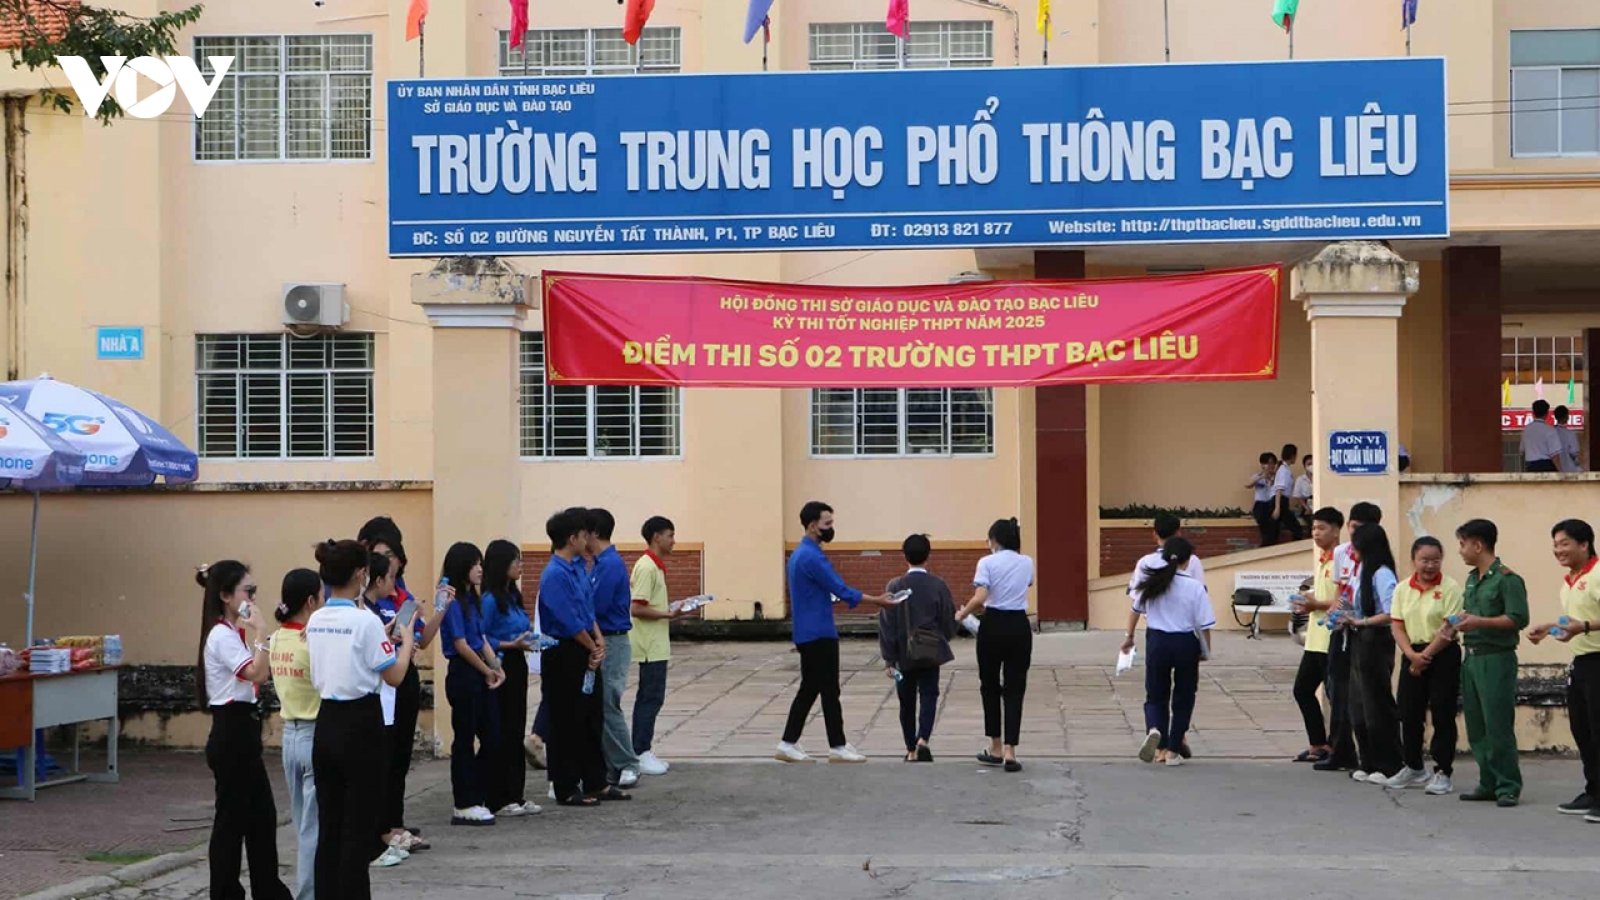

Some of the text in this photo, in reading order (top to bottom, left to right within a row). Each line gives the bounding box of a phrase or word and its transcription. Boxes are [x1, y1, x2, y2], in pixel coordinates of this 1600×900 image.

[398, 82, 595, 98] ỦY BAN NHÂN DÂN TỈNH BẠC LIÊU
[424, 99, 571, 115] SỞ GIÁO DỤC VÀ ĐÀO TẠO
[412, 96, 1417, 199] TRƯỜNG TRUNG HỌC PHỔ THÔNG BẠC LIÊU
[412, 222, 835, 246] ĐC: SỐ 02 ĐƯỜNG NGUYỄN TẤT THÀNH, P1, TP BẠC LIÊU
[870, 222, 1013, 237] ĐT: 02913 821 877
[1049, 220, 1116, 235] Website:
[720, 294, 749, 313] HỘI
[752, 293, 797, 312] ĐỒNG
[800, 299, 827, 312] THI
[855, 297, 894, 313] GIÁO
[897, 299, 931, 316] DỤC
[934, 296, 955, 313] VÀ
[957, 296, 991, 313] ĐÀO
[994, 297, 1025, 315] TẠO
[1029, 295, 1060, 315] BẠC
[1063, 292, 1099, 309] LIÊU
[773, 314, 1045, 334] KỲ THI TỐT NGHIỆP THPT NĂM 2025
[100, 333, 140, 352] NHÀ A
[622, 330, 1198, 368] ĐIỂM THI SỐ 02 TRƯỜNG THPT BẠC LIÊU
[84, 453, 119, 466] one
